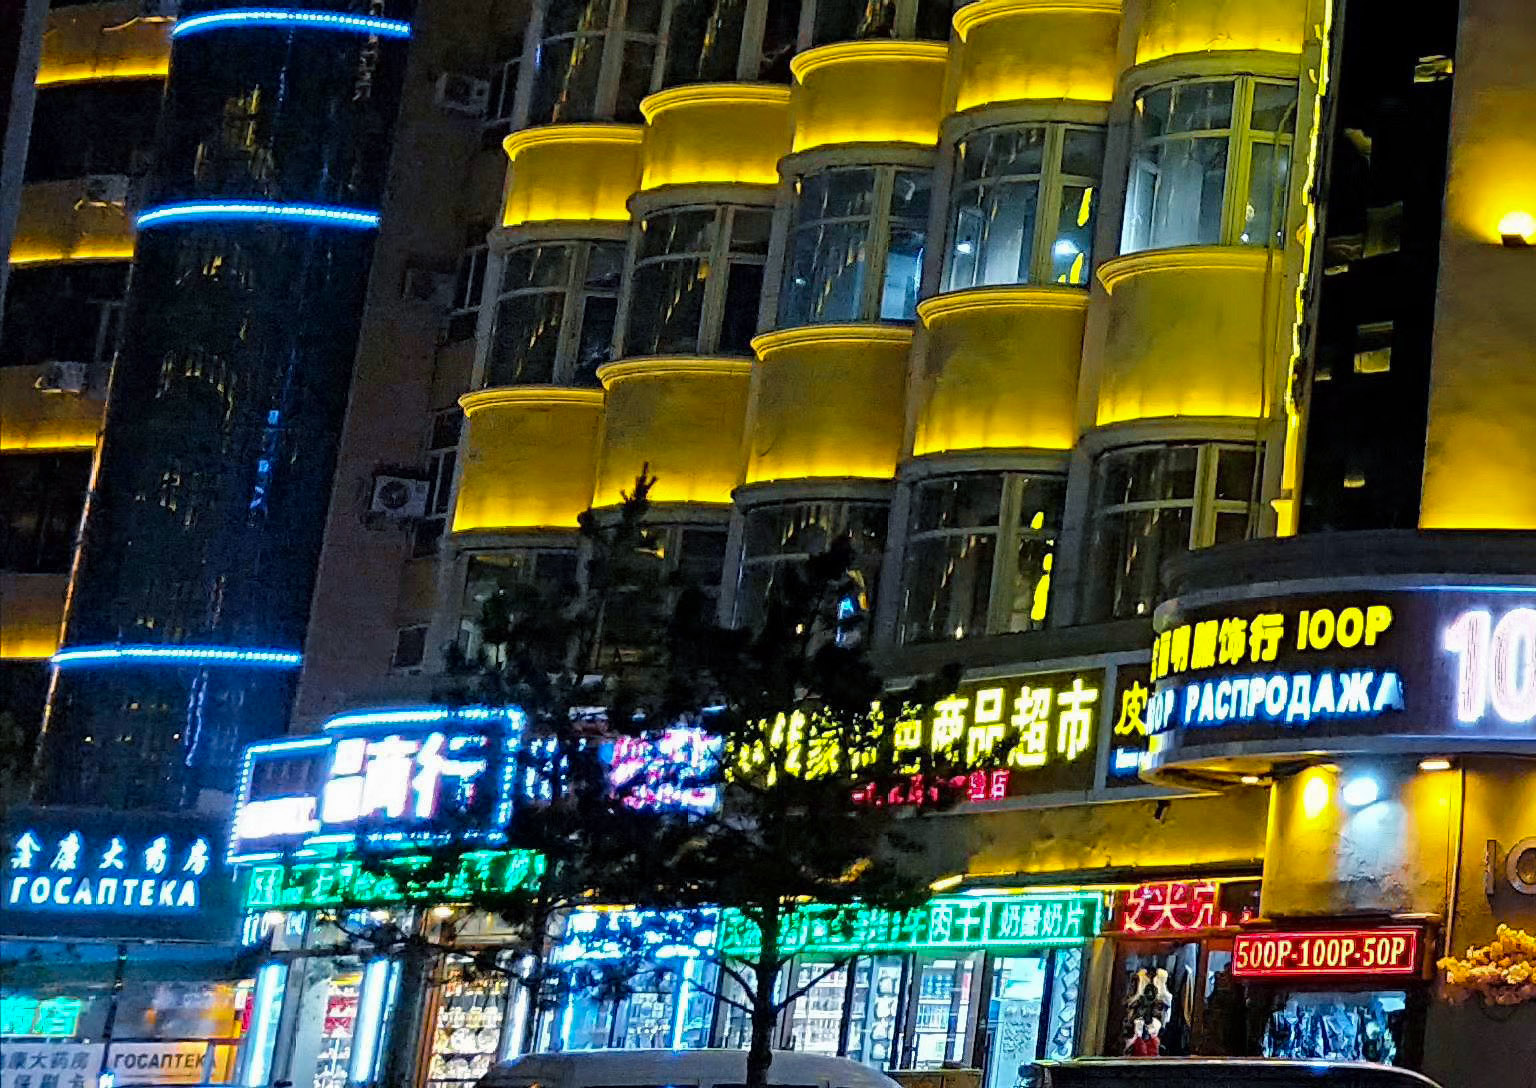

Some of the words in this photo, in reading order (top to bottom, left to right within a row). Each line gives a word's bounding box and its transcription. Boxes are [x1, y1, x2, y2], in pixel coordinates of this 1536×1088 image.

[1183, 670, 1404, 724] РАСПРОДАЖА
[9, 876, 196, 907] ГОСАПТЕКА
[1237, 938, 1406, 968] 500P-100P-50P
[0, 1052, 91, 1070] 康大药房
[114, 1054, 212, 1071] ГОСАПТЕК
